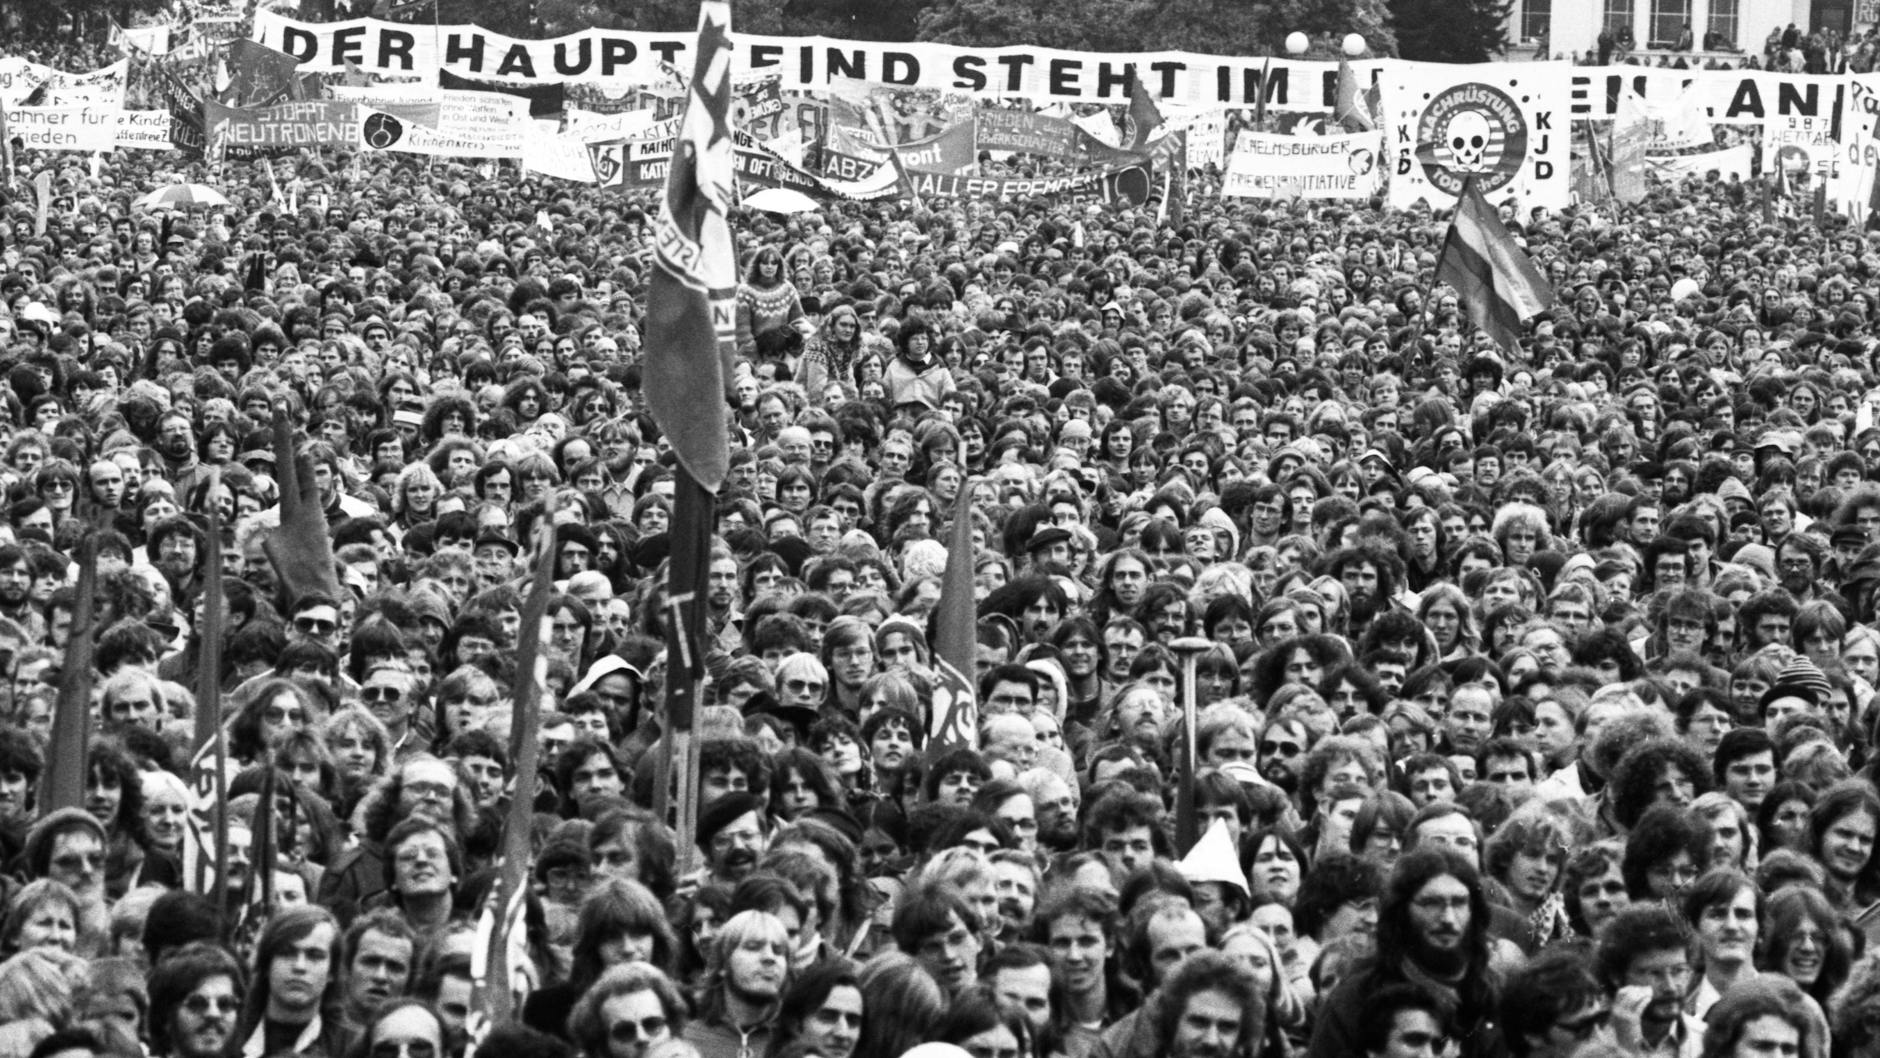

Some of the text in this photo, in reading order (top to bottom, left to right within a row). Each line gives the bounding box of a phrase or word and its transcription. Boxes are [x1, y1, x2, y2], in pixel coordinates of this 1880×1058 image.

[283, 26, 416, 70] DER
[952, 54, 1186, 98] STEHT
[1217, 65, 1289, 105] IM
[258, 102, 328, 121] STOPPT
[977, 112, 1035, 130] FRIEDEN
[8, 126, 77, 144] Frieden
